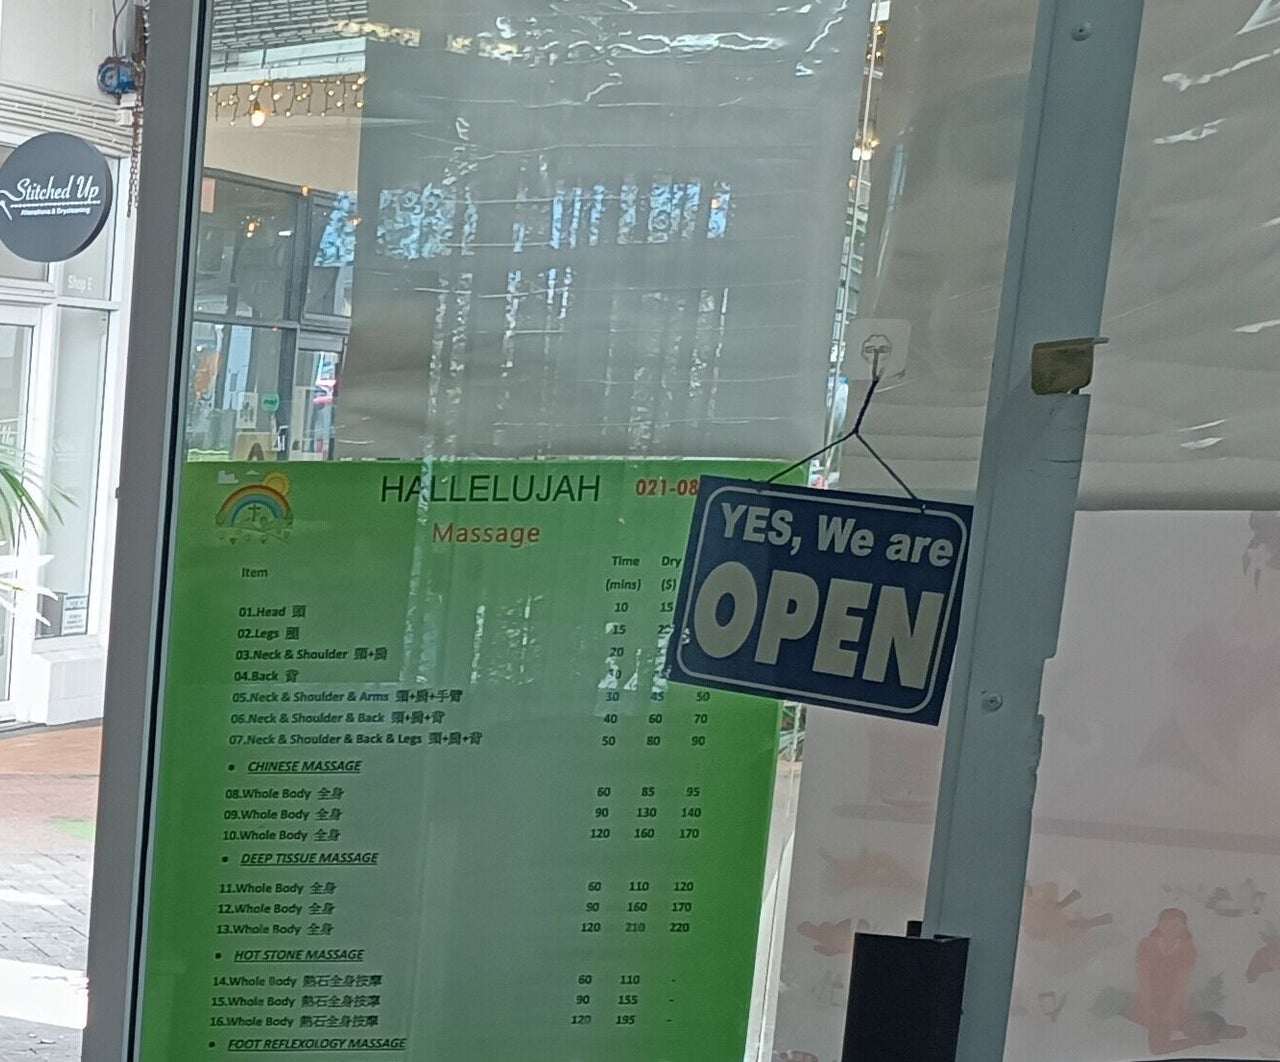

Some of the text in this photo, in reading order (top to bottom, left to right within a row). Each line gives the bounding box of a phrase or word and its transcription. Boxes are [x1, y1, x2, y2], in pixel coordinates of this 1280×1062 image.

[11, 175, 99, 203] Stitched Up
[68, 275, 87, 292] Shop
[380, 475, 601, 502] HALLELUJAH
[636, 479, 699, 496] 021-08
[432, 523, 540, 549] Massage
[721, 503, 955, 568] YES, We are
[612, 556, 682, 569] Time Dry
[241, 567, 268, 579] Item
[606, 579, 641, 592] (mins)
[693, 560, 944, 690] OPEN
[237, 628, 279, 640] 02.Legs
[297, 649, 347, 660] Shoulder
[293, 691, 389, 702] Shoulder Arms
[291, 713, 385, 724] Shoulder Back
[290, 733, 422, 745] Shoulder Back Legs
[248, 761, 362, 772] CHINESE MASSAGE
[282, 789, 311, 800] Body
[224, 810, 277, 820] 09.Whole
[280, 810, 309, 821] Body
[223, 830, 276, 841] 10.Whole
[279, 830, 307, 842] Body
[241, 853, 379, 864] DEEP TISSUE MASSAGE
[275, 883, 303, 895] Body
[218, 904, 271, 914] 12.Whole
[274, 903, 302, 915] Body
[672, 902, 692, 912] 170
[273, 924, 301, 936] Body
[581, 923, 690, 932] 120 220
[234, 950, 364, 961] HOT STONE MASSAGE
[578, 975, 640, 984] 60 110
[211, 997, 295, 1008] 15.Whole Body
[265, 1017, 293, 1029] Body
[228, 1038, 406, 1049] FOOT REFLEXOLOGY MASSAGE
